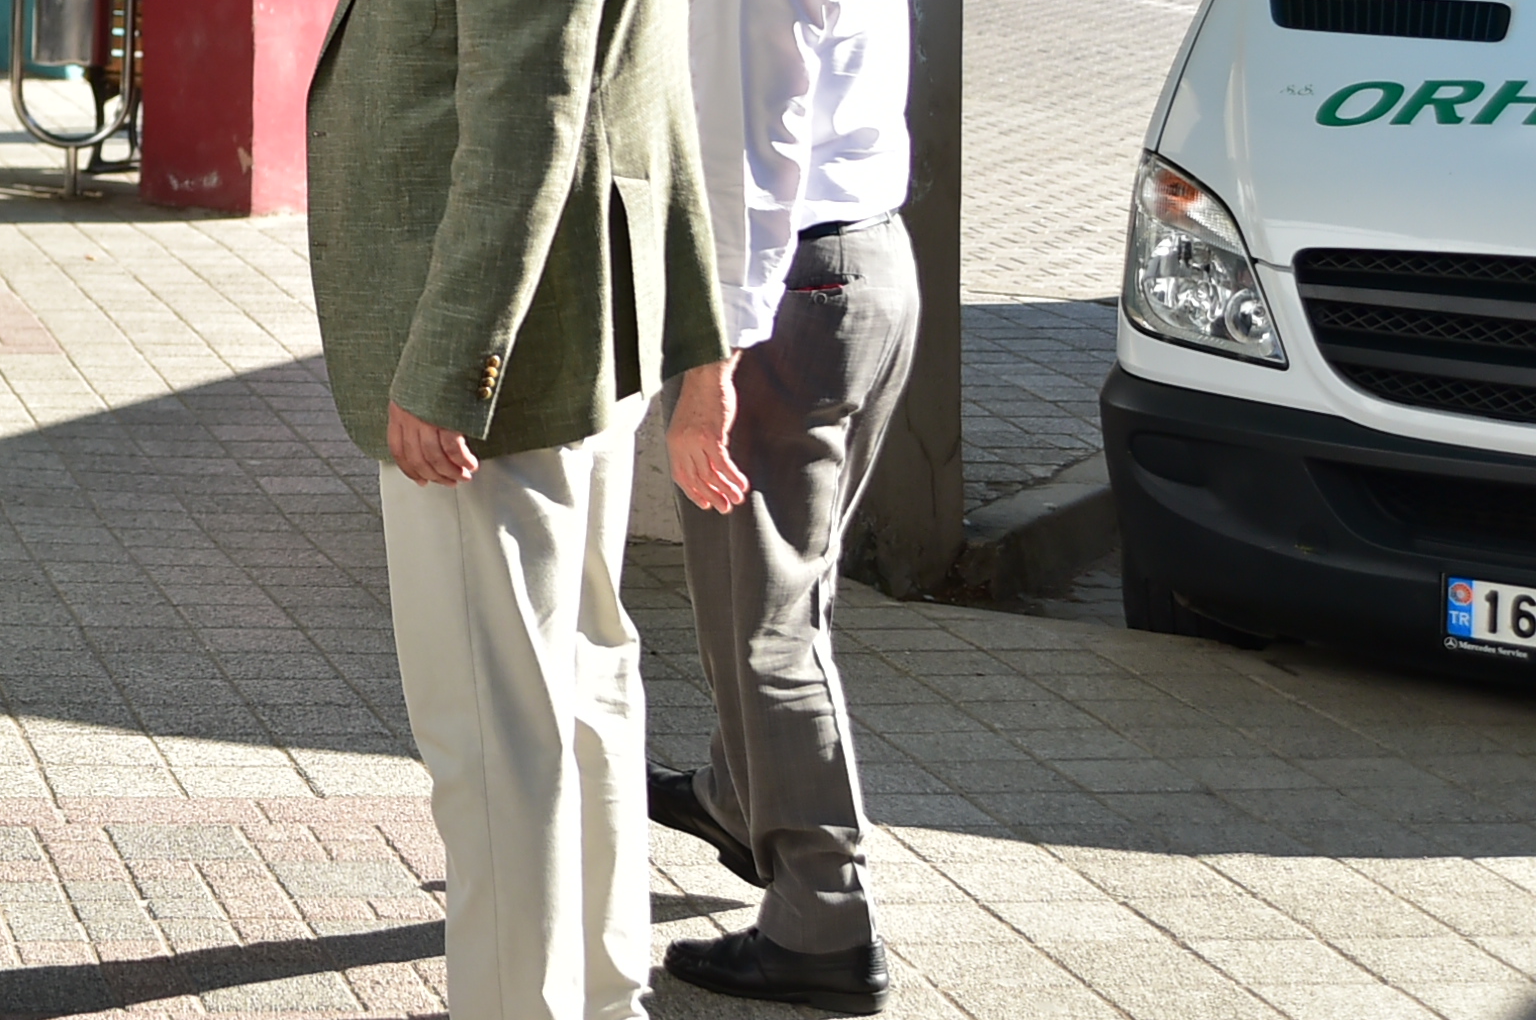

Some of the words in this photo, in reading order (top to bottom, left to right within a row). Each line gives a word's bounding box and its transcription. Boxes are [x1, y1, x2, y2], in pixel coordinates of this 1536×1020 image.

[1448, 610, 1470, 627] TR
[1484, 589, 1536, 639] 16
[1458, 640, 1497, 654] Mercedes
[1497, 646, 1528, 659] Service
